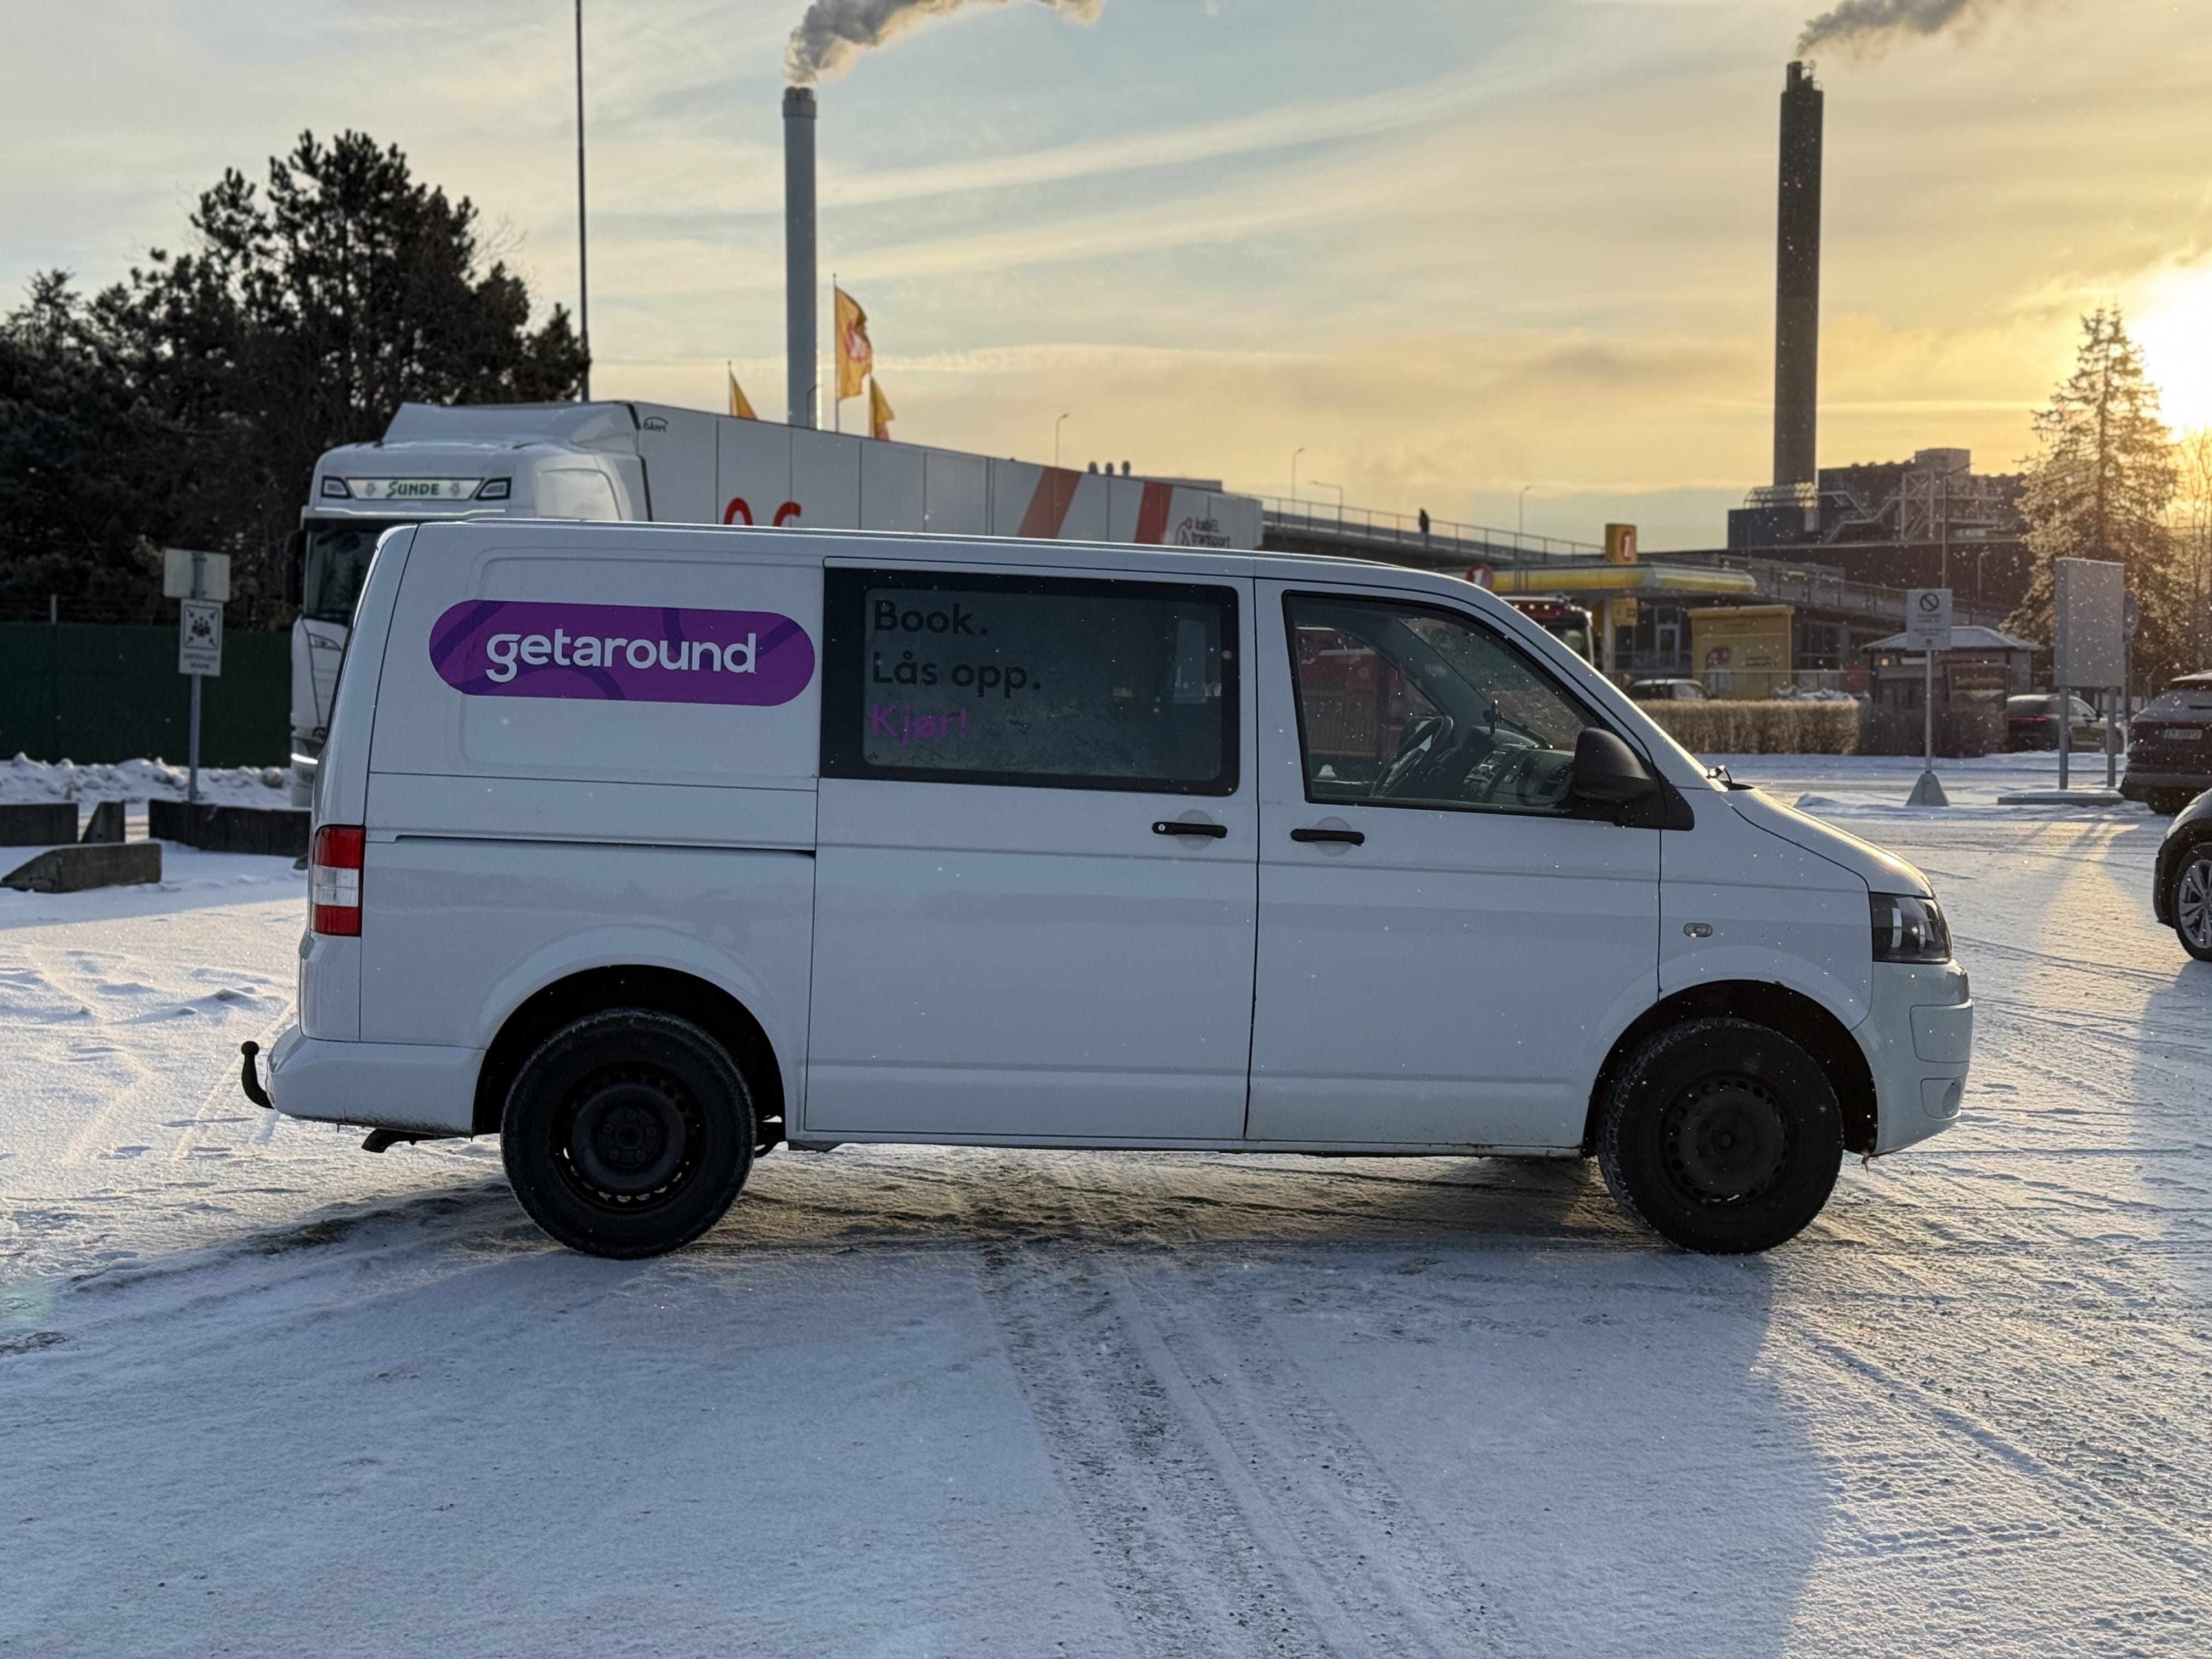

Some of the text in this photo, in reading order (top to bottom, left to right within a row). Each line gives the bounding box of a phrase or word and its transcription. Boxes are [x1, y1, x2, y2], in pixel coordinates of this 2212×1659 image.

[386, 480, 439, 499] SUNDE
[1192, 532, 1231, 548] transport
[874, 600, 988, 635] Book.
[486, 629, 757, 682] getaround
[873, 651, 1041, 698] Lås opp.
[871, 705, 968, 747] Kjør!
